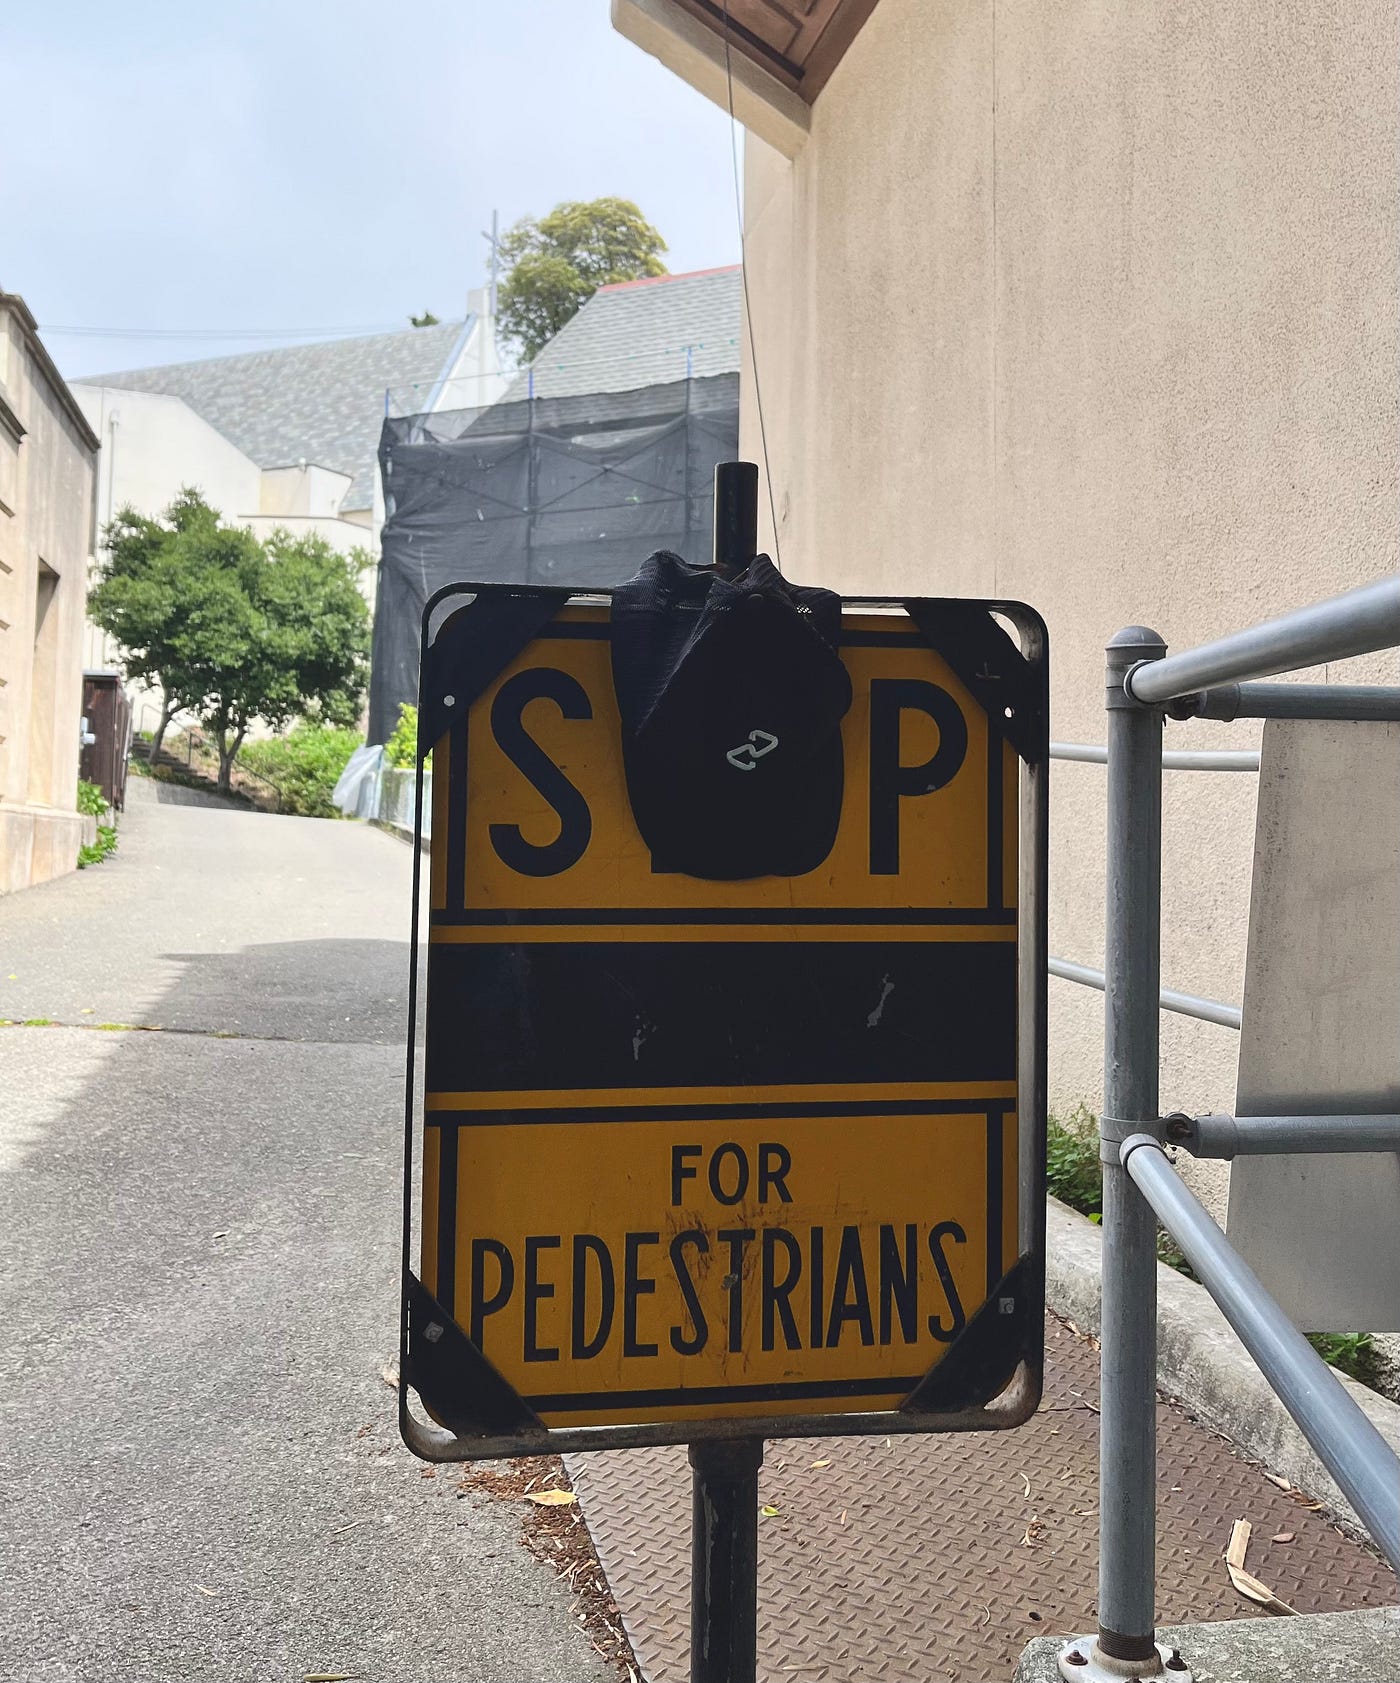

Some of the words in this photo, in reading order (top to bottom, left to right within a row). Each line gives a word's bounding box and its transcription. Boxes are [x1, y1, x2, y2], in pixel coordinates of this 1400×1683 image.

[488, 667, 969, 877] SP
[671, 1142, 794, 1206] FOR
[470, 1221, 968, 1362] PEDESTRIANS
